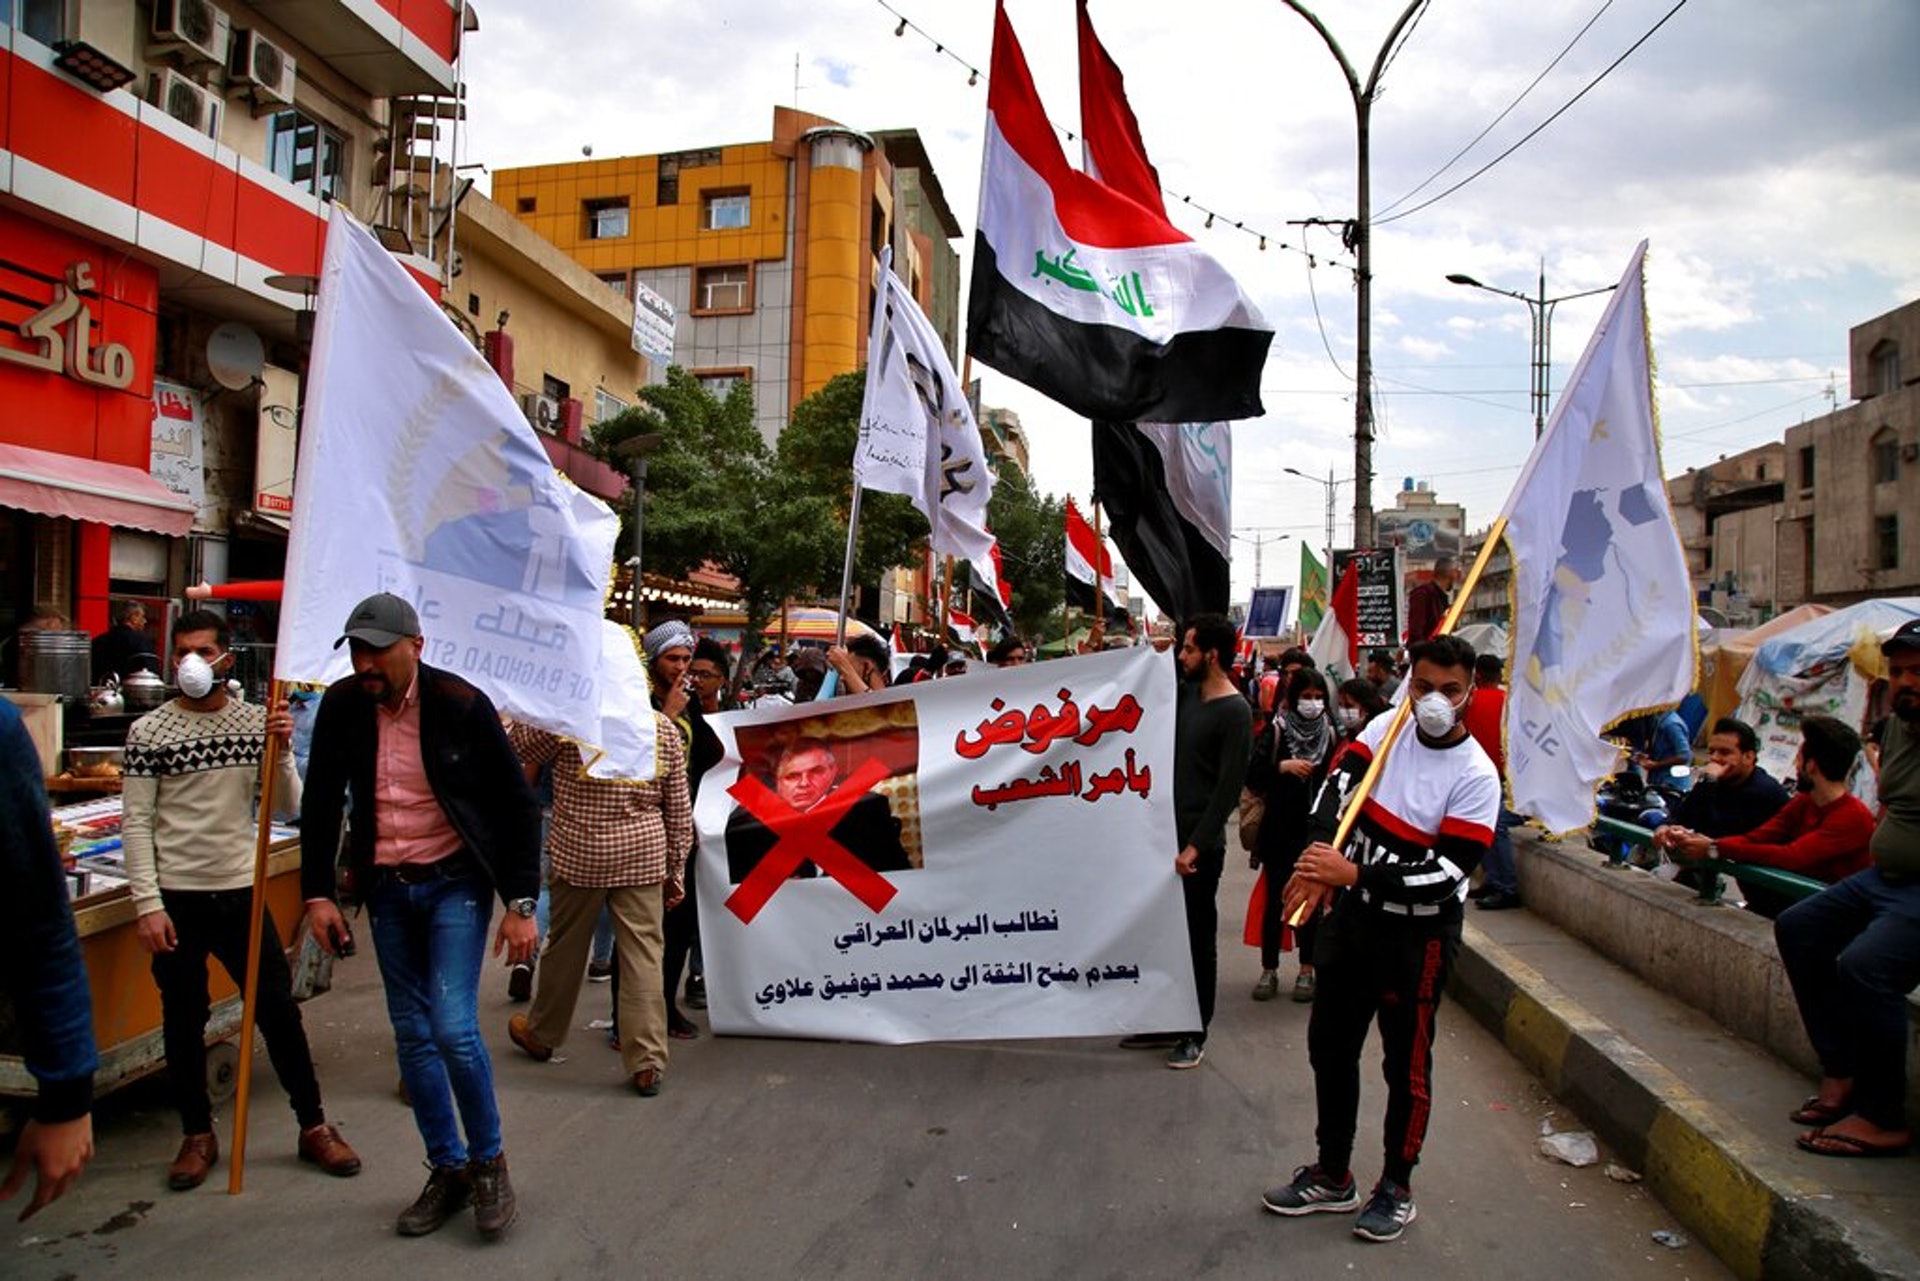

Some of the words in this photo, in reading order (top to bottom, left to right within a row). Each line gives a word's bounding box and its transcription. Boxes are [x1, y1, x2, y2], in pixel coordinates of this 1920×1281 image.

[955, 687, 1144, 759] مرفوض
[971, 759, 1083, 811] الشعب
[1081, 748, 1151, 803] بأمر
[833, 918, 914, 954] العراقي
[919, 913, 988, 943] البرلمان
[992, 909, 1059, 939] نطالب
[819, 969, 883, 1001] توفيق
[886, 968, 944, 992] محمد
[982, 959, 1033, 985] الثقة
[1036, 963, 1079, 990] منح
[1085, 961, 1140, 989] بعدم
[755, 976, 815, 1010] علاوي
